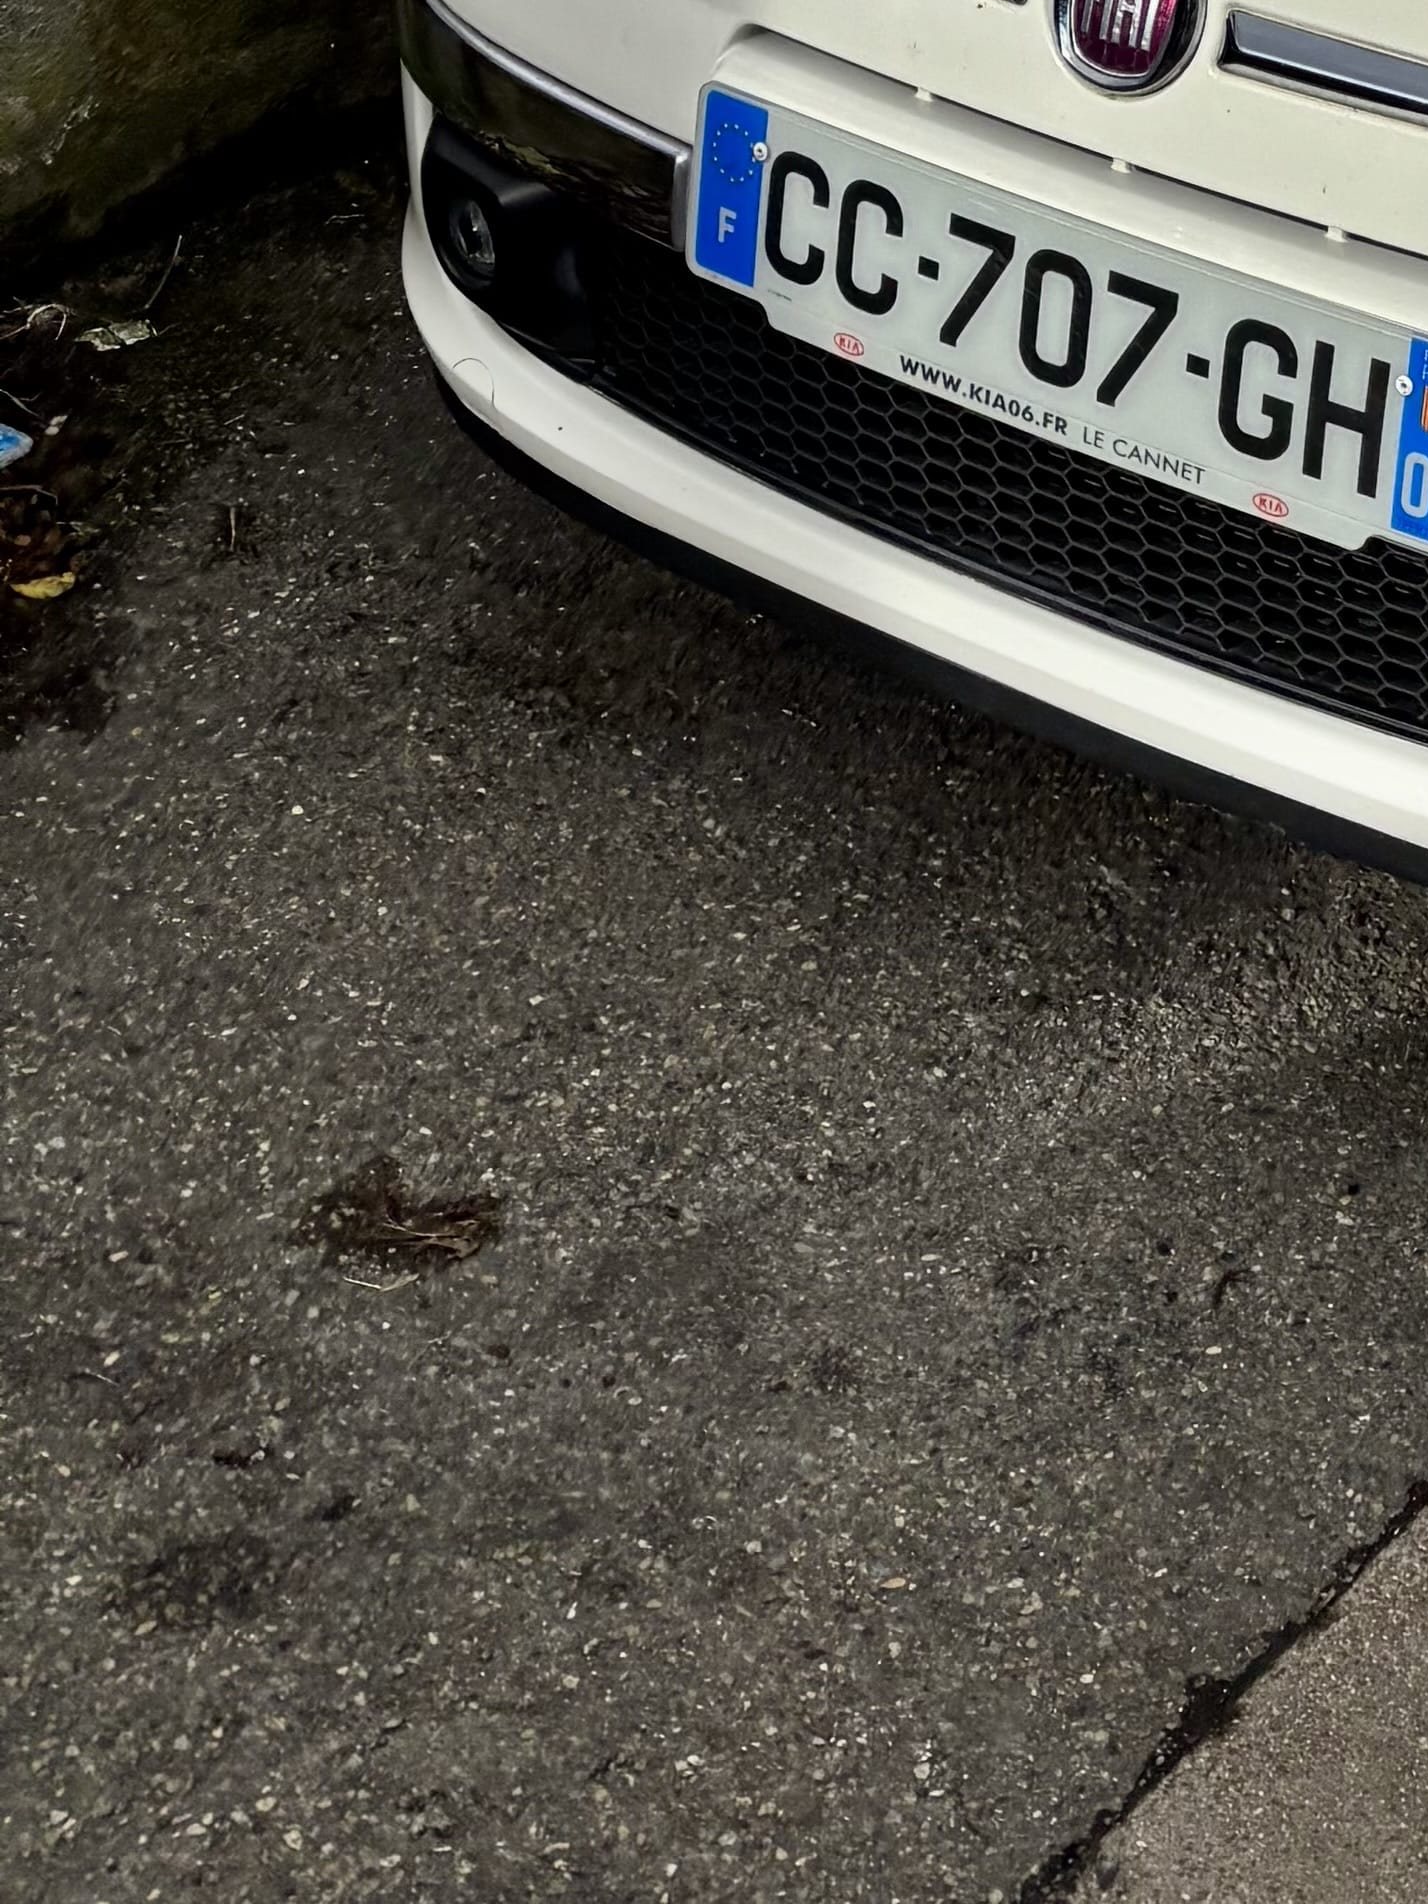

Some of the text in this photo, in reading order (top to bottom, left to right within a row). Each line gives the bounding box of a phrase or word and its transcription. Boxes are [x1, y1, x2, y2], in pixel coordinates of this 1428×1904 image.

[717, 206, 737, 244] F
[764, 150, 1391, 499] CC-707-GH
[837, 334, 862, 356] KIA
[899, 354, 1206, 485] WWW.KIA06.FR LE CANNET
[1256, 495, 1286, 515] KIA
